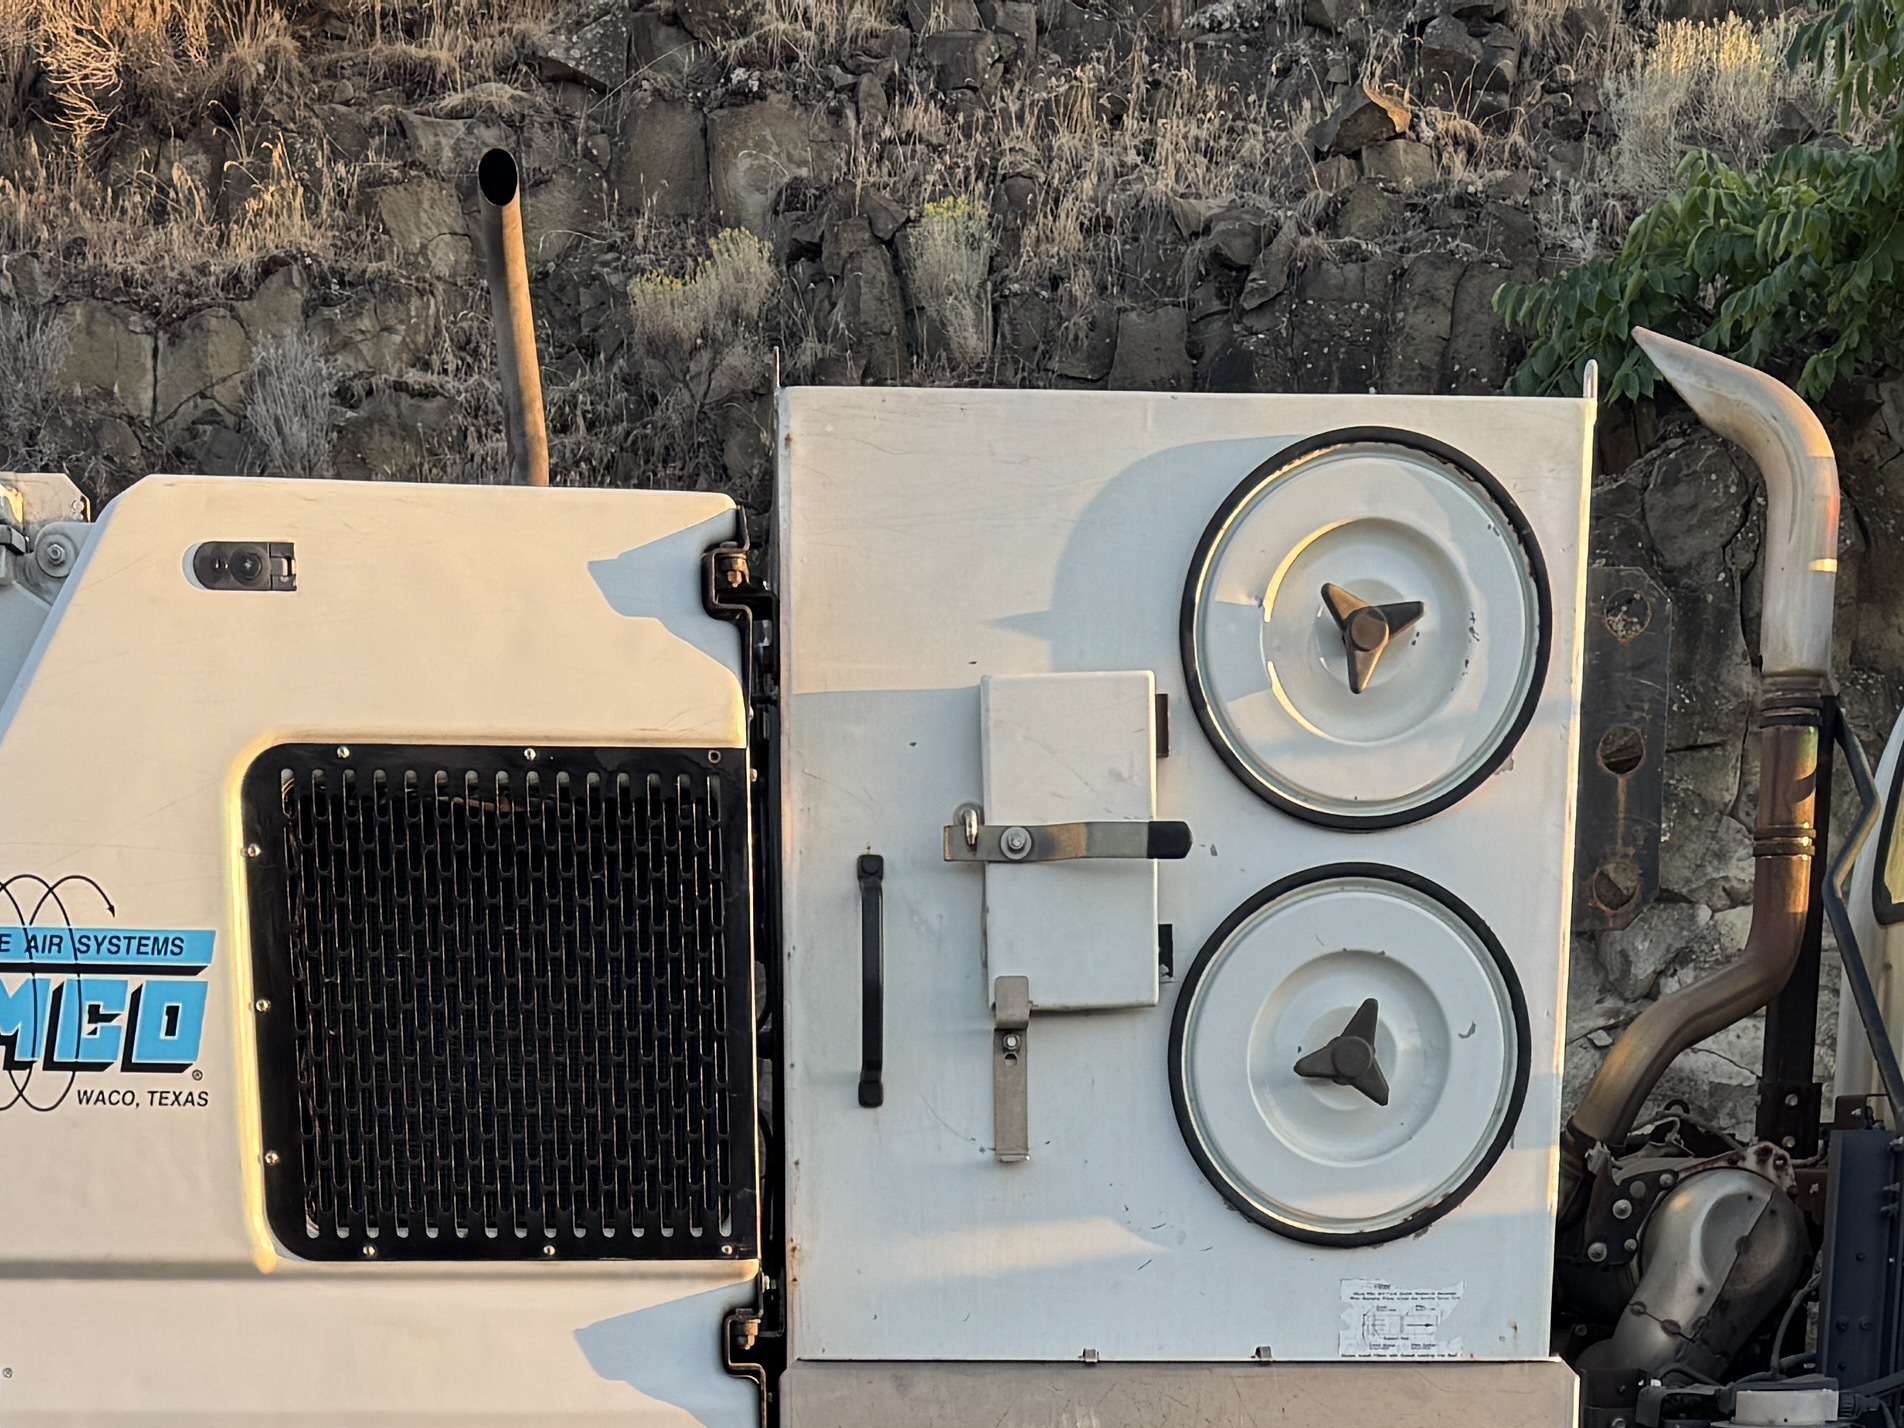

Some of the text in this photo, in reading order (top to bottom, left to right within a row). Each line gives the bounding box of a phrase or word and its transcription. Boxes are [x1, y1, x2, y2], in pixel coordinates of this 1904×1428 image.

[25, 932, 63, 955] AIR
[76, 933, 185, 957] SYSTEMS
[76, 1089, 209, 1108] WACO, TEXAS
